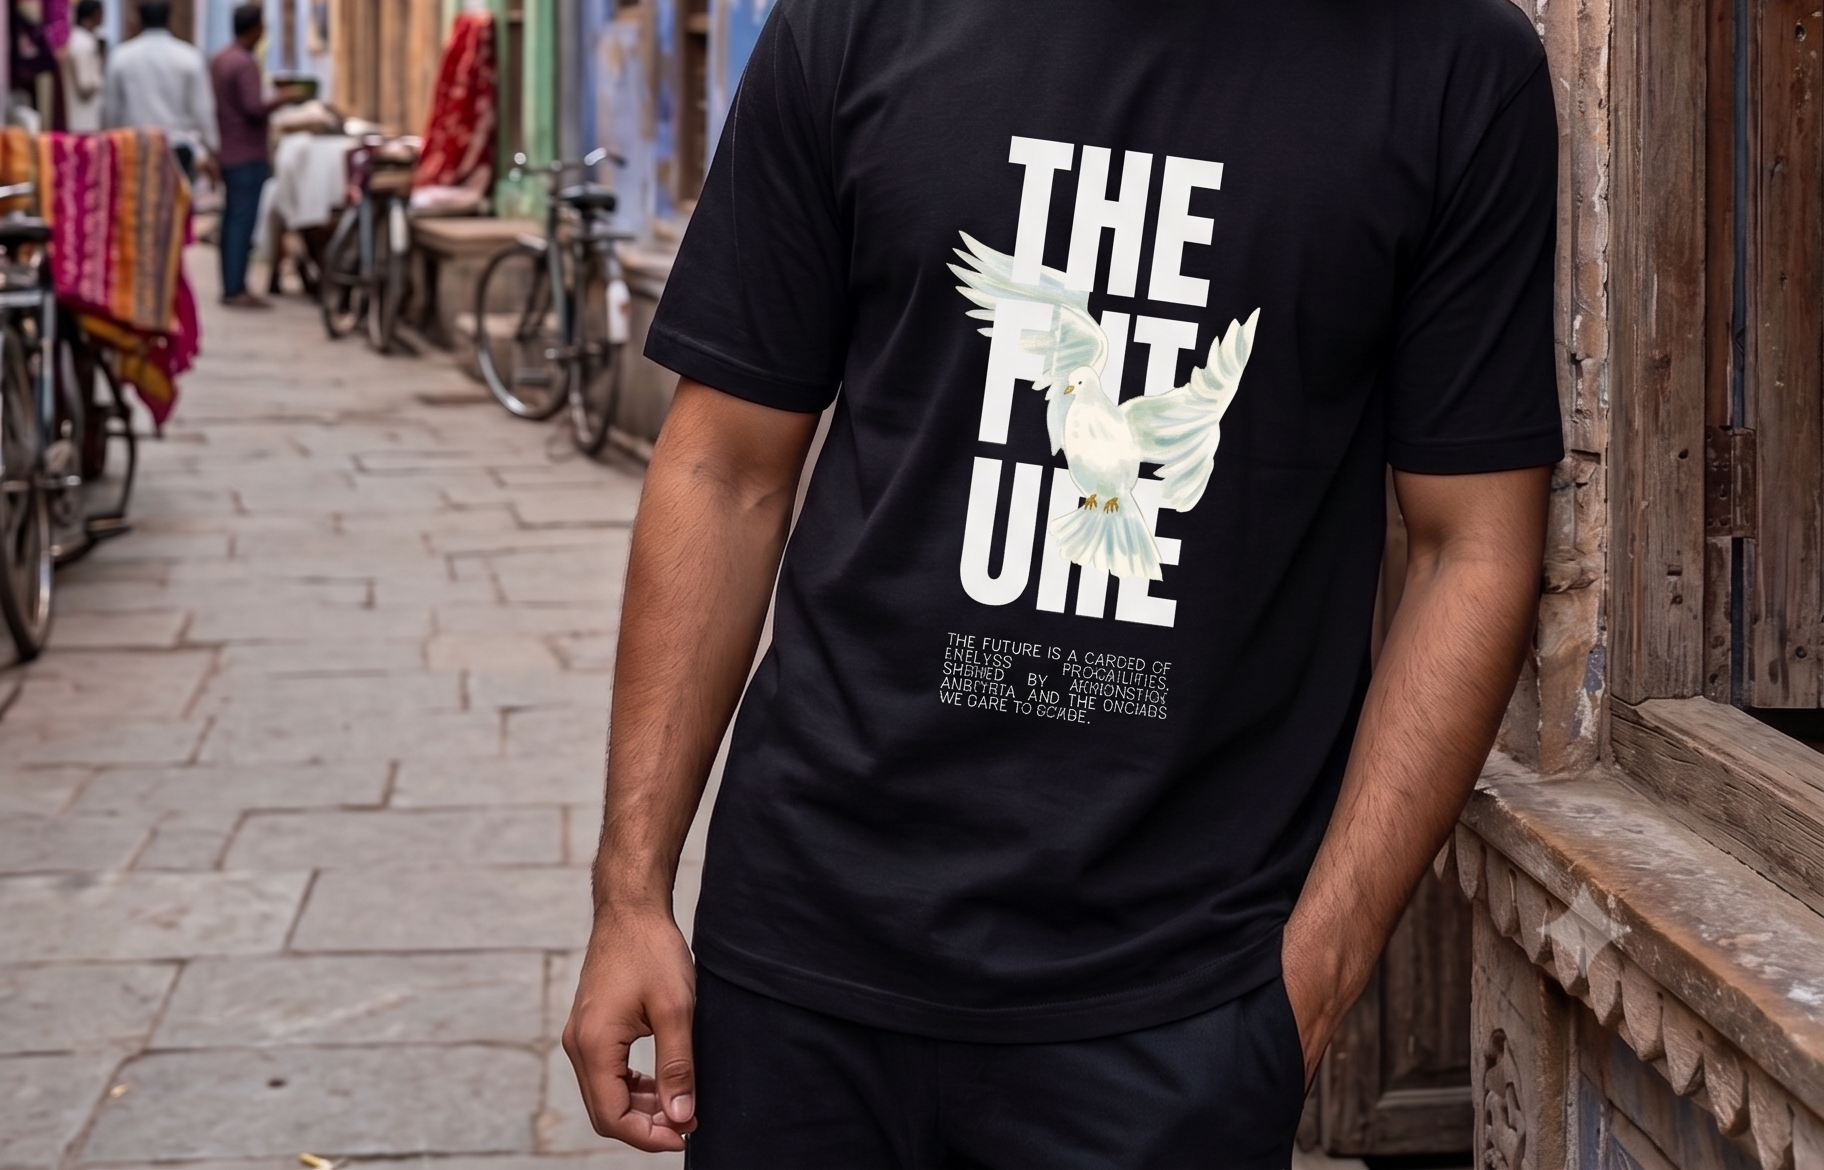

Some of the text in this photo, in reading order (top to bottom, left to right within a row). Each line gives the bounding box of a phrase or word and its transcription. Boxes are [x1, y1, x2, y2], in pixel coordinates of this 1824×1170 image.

[1008, 136, 1224, 308] THE
[948, 632, 975, 648] THE
[983, 638, 1041, 657] FUTURE
[1048, 647, 1061, 660] IS
[1067, 650, 1077, 661] A
[1028, 673, 1048, 687] BY
[940, 690, 962, 706] WE
[1014, 700, 1032, 714] TO
[1028, 689, 1059, 704] AND
[1069, 693, 1096, 710] THE
